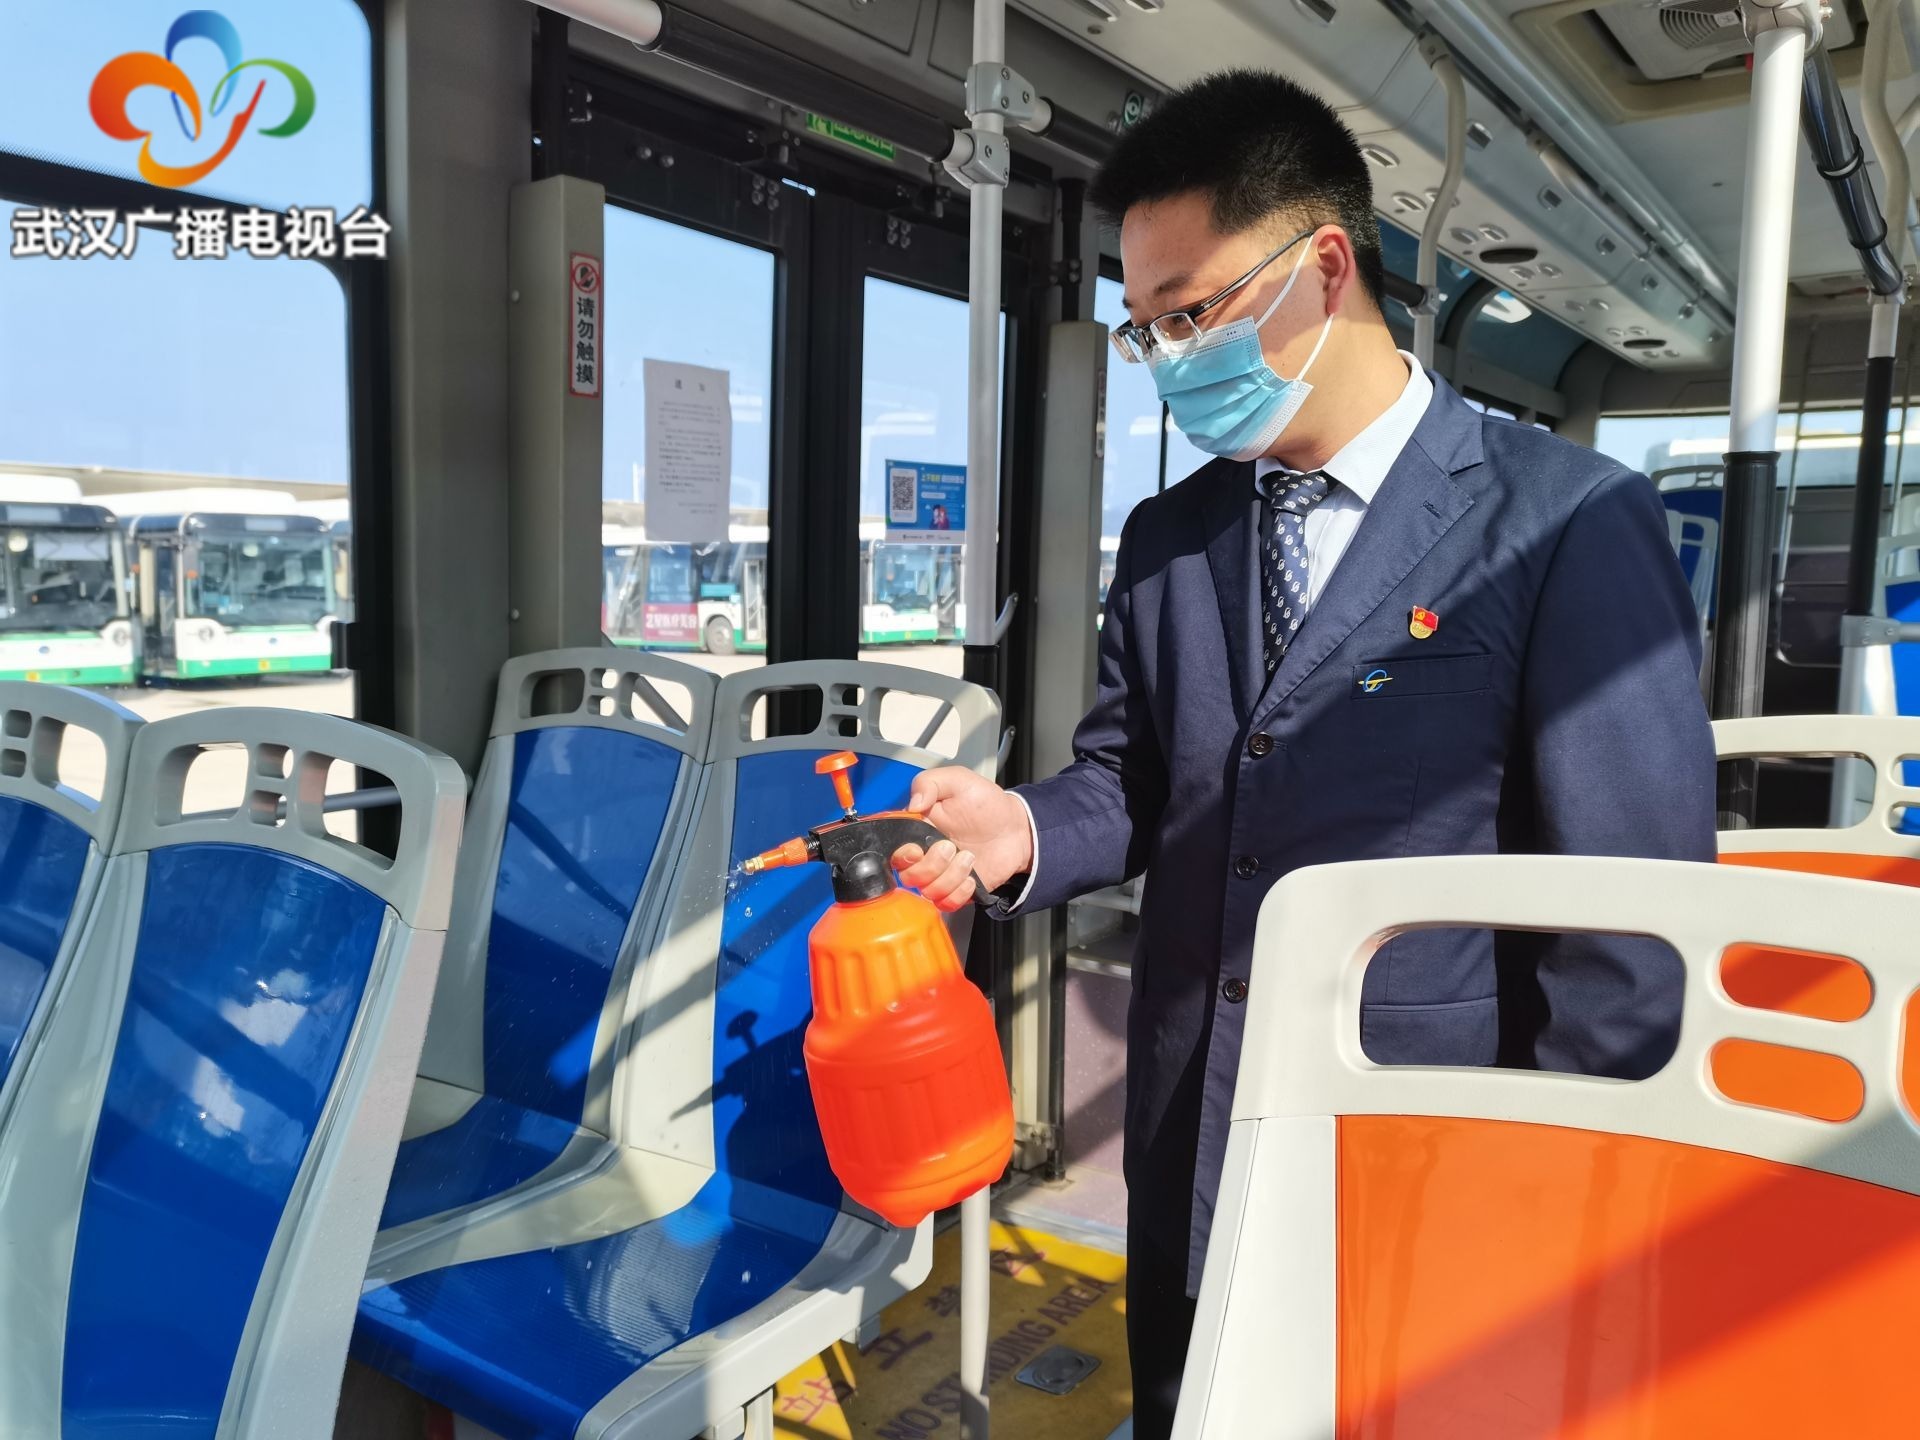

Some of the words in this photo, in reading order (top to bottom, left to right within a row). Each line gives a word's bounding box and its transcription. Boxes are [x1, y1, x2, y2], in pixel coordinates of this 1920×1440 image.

[576, 297, 595, 385] 请勿触摸
[921, 1318, 1056, 1413] STNDING
[1036, 1276, 1119, 1327] AREA
